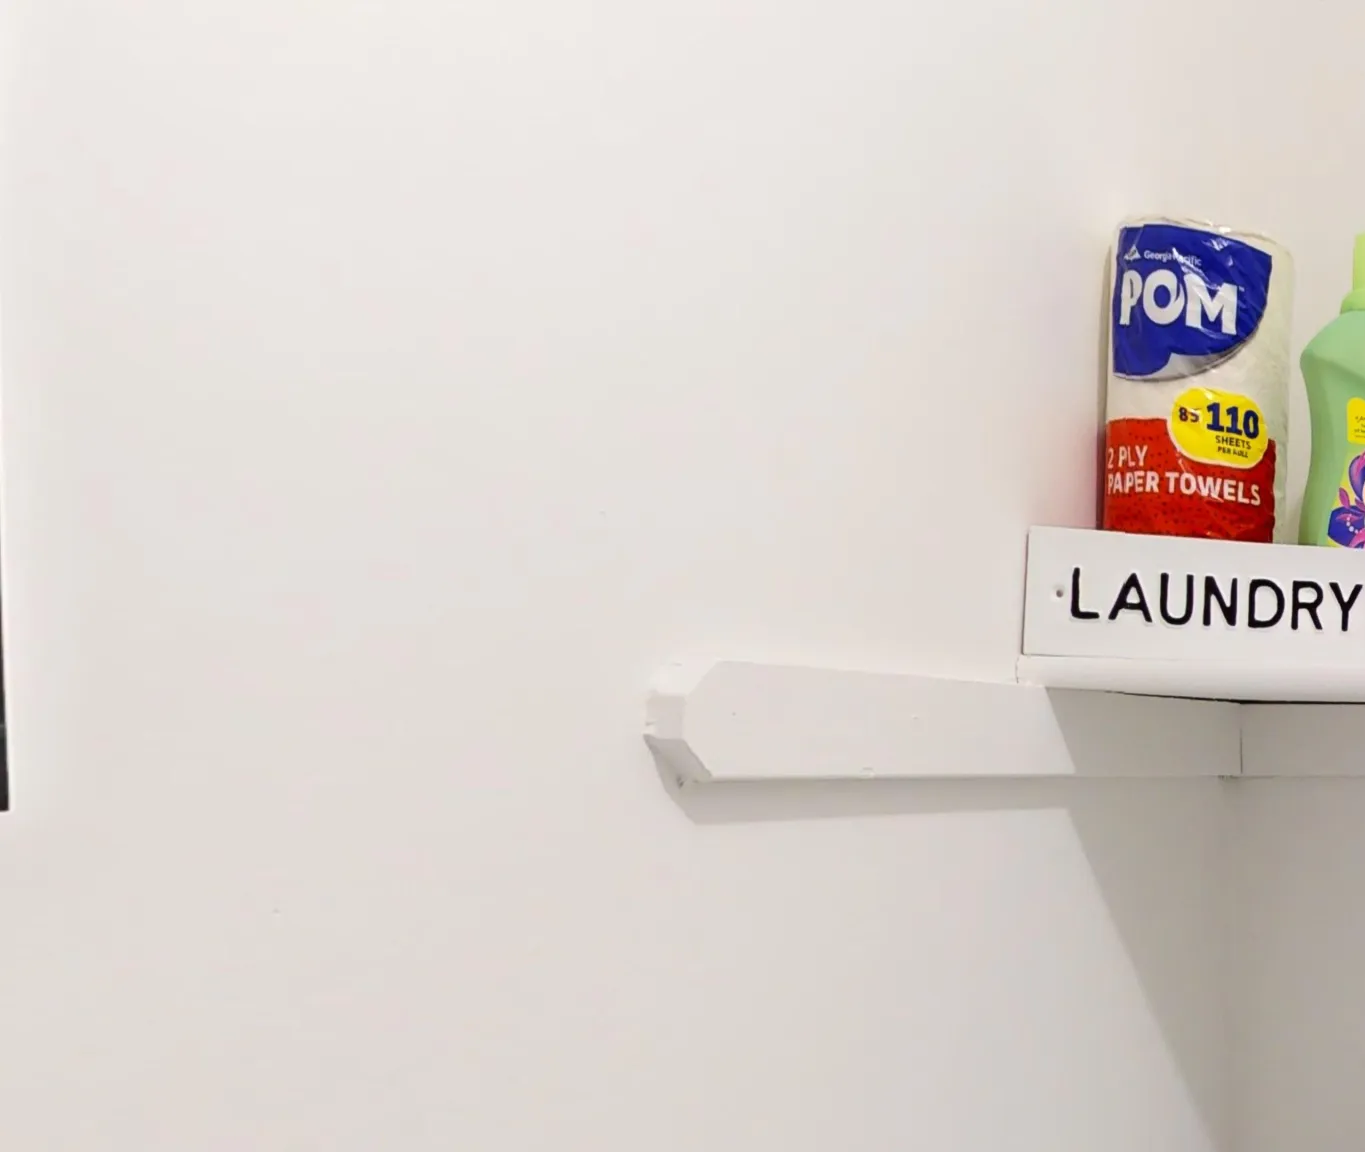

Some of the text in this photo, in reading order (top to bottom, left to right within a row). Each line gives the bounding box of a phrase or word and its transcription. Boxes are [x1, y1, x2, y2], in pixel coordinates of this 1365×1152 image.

[1119, 268, 1238, 336] POM
[1178, 402, 1259, 439] 85 110
[1107, 445, 1148, 469] 2 PLY
[1215, 435, 1252, 450] SHEETS
[1217, 446, 1232, 454] PER
[1107, 471, 1261, 506] PAPER TOWELS
[1070, 566, 1363, 632] LAUNDRY
